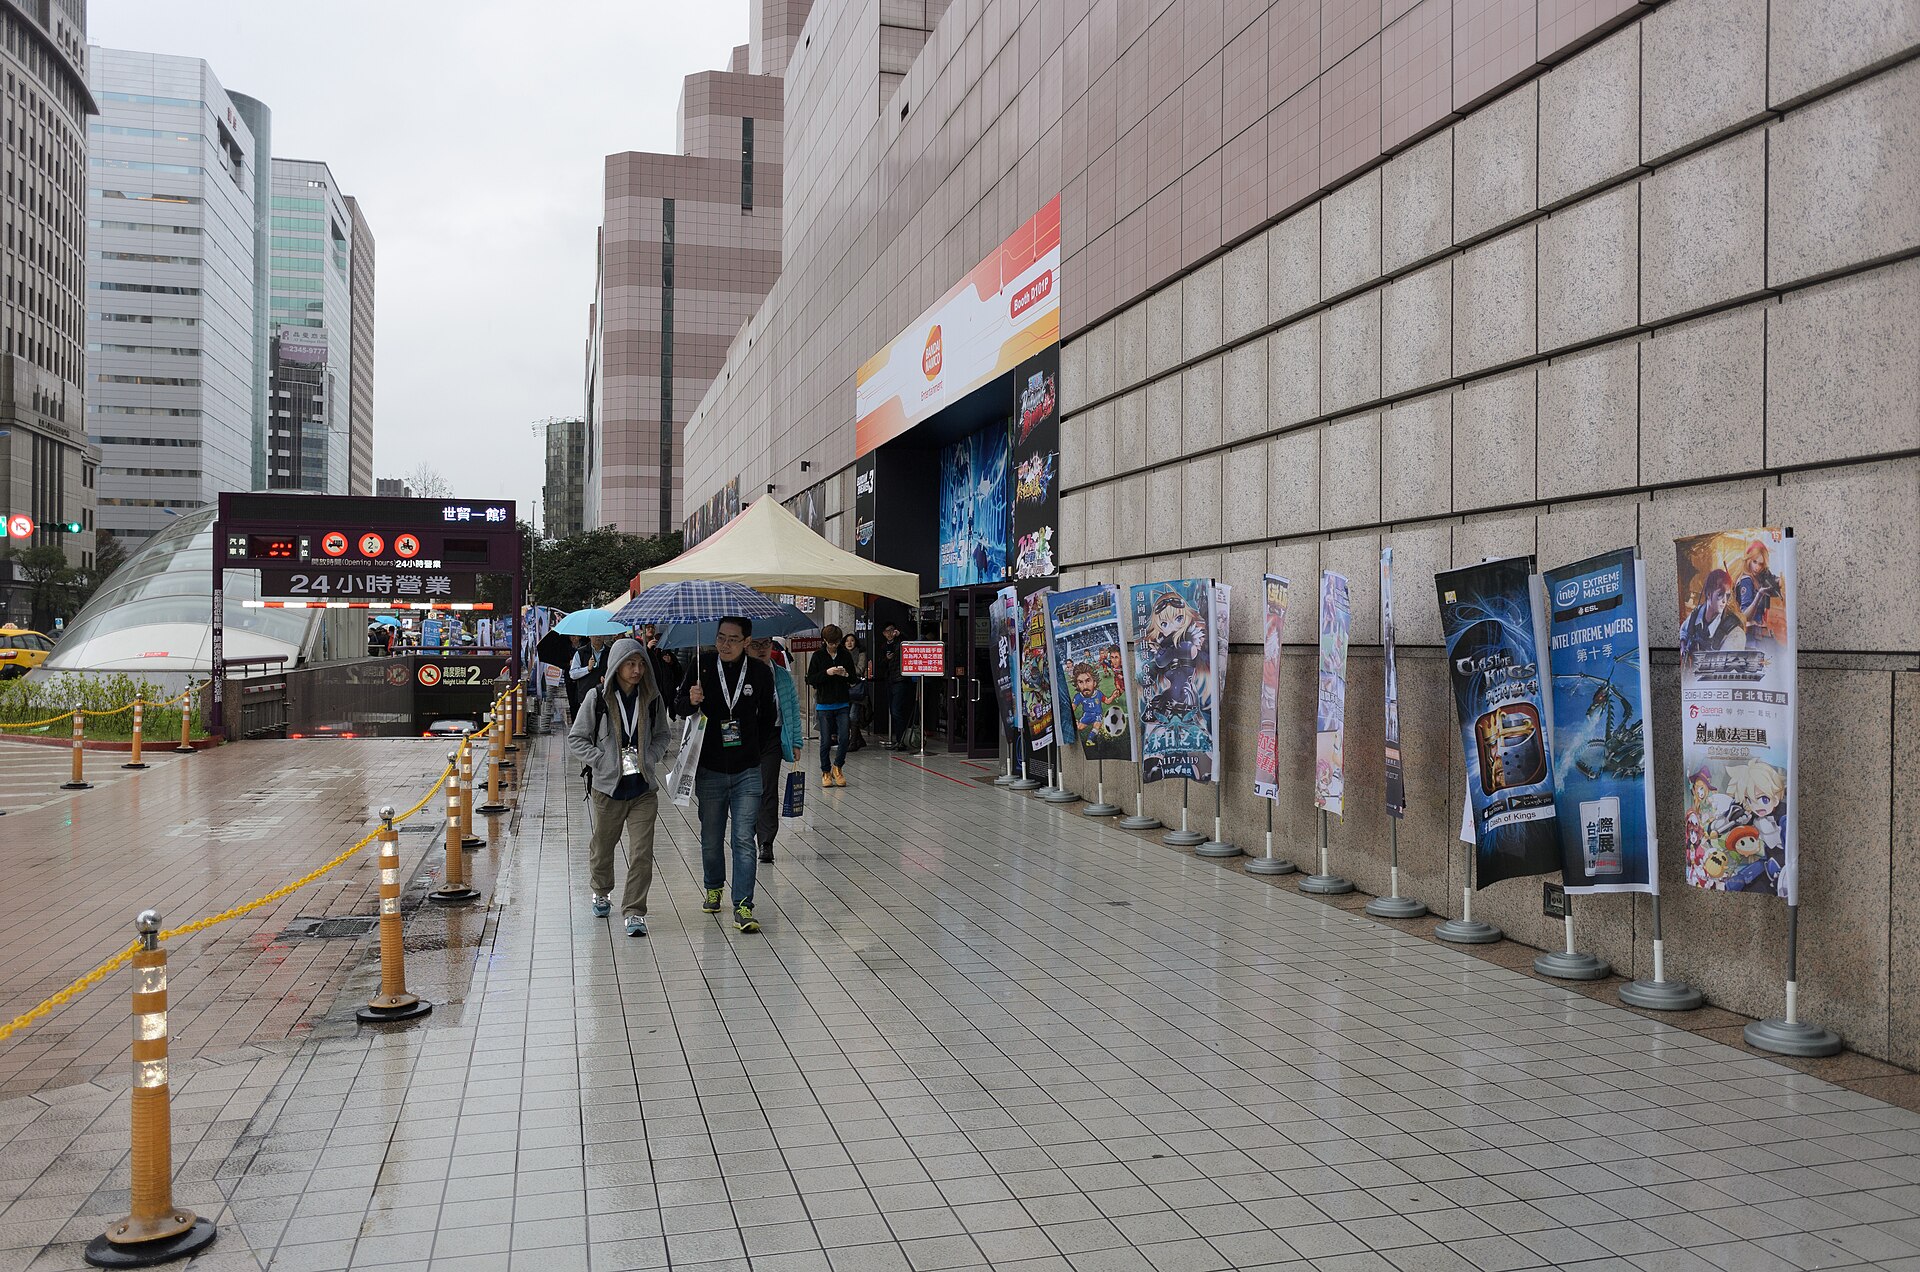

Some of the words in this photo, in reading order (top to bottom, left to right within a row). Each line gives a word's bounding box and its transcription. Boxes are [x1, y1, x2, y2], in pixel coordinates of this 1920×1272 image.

[1014, 291, 1030, 312] Booth
[1031, 276, 1049, 301] D101P
[289, 345, 326, 355] 2345-9777
[925, 338, 941, 360] BANDAI
[925, 352, 941, 373] NAMCO
[367, 541, 374, 549] 2
[290, 574, 452, 595] 24小時營業
[1552, 633, 1569, 650] INTEL
[1571, 625, 1603, 645] EXTREME
[1576, 643, 1613, 663] 第十季
[1456, 653, 1501, 676] CLASH
[1500, 656, 1511, 667] OF
[443, 666, 466, 678] 高度限制
[466, 665, 481, 685] 2
[443, 678, 455, 686] Height
[1484, 662, 1536, 688] KINGS
[1734, 690, 1787, 704] 台北電玩展
[1700, 706, 1723, 714] Garena
[1151, 729, 1204, 750] 末日之子
[1696, 722, 1768, 745] 劍與魔法王國
[1523, 799, 1543, 807] Google
[1513, 811, 1537, 820] Kings
